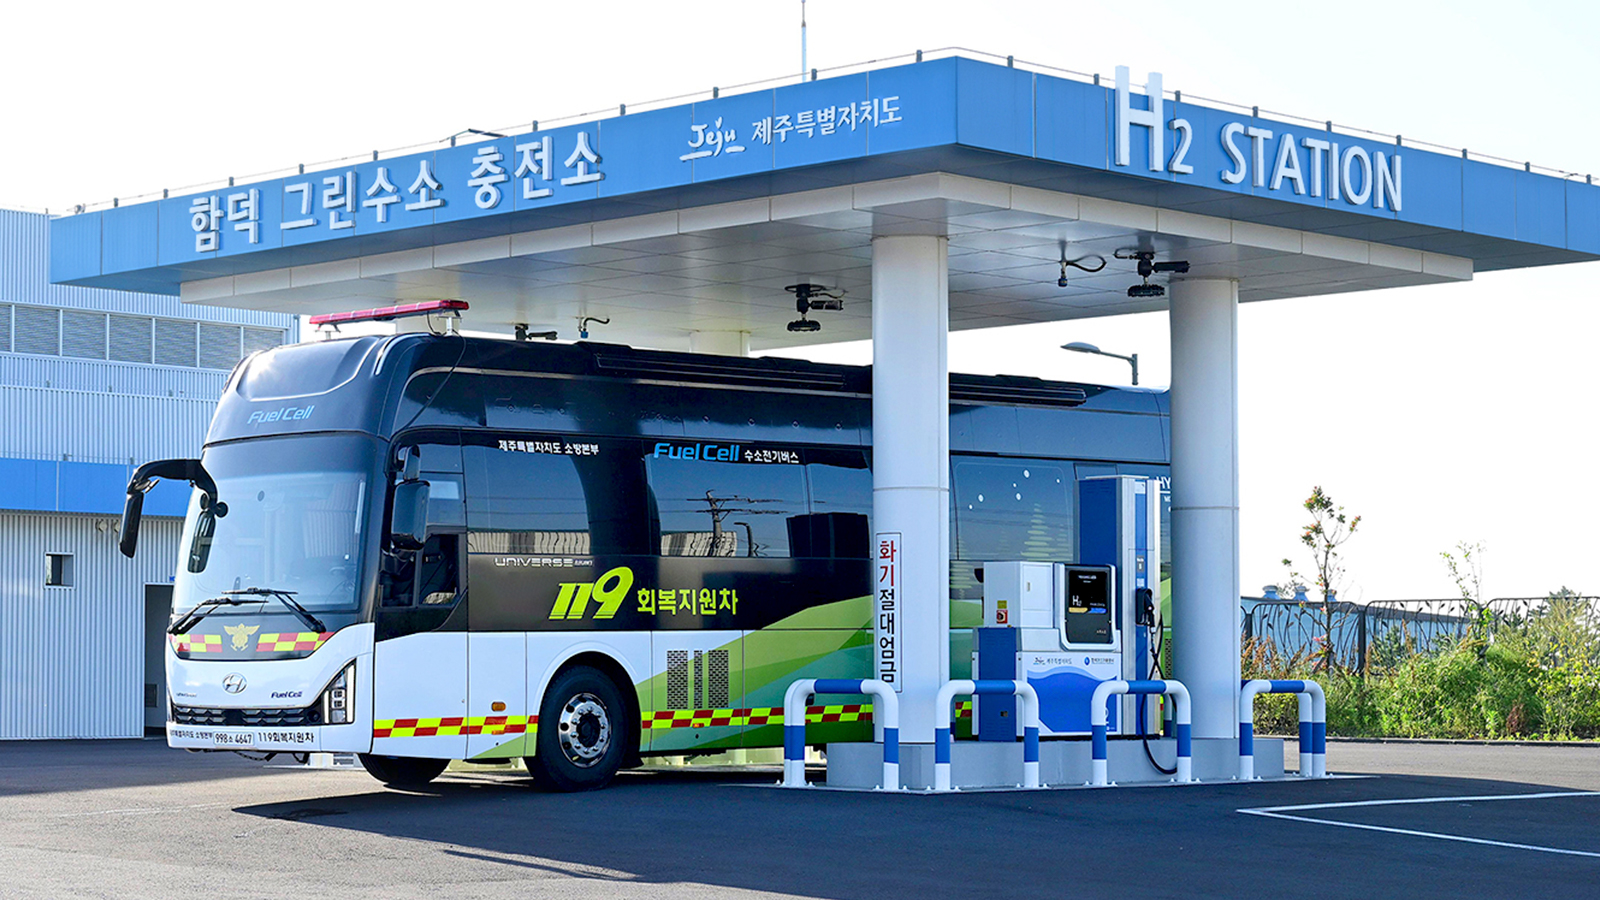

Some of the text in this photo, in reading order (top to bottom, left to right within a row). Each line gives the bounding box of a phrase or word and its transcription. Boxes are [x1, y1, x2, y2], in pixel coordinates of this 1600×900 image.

[685, 96, 903, 157] Jeju 제주특별자치도
[1115, 65, 1402, 212] H2 STATION
[189, 130, 605, 252] 함덕 그린수소 충전소
[498, 440, 599, 455] 제주특별자치도 소방본부
[744, 450, 799, 463] 수소전기버스
[494, 557, 573, 568] UNIVERSE
[549, 566, 739, 620] 119 회복지원차
[234, 733, 253, 744] 4647
